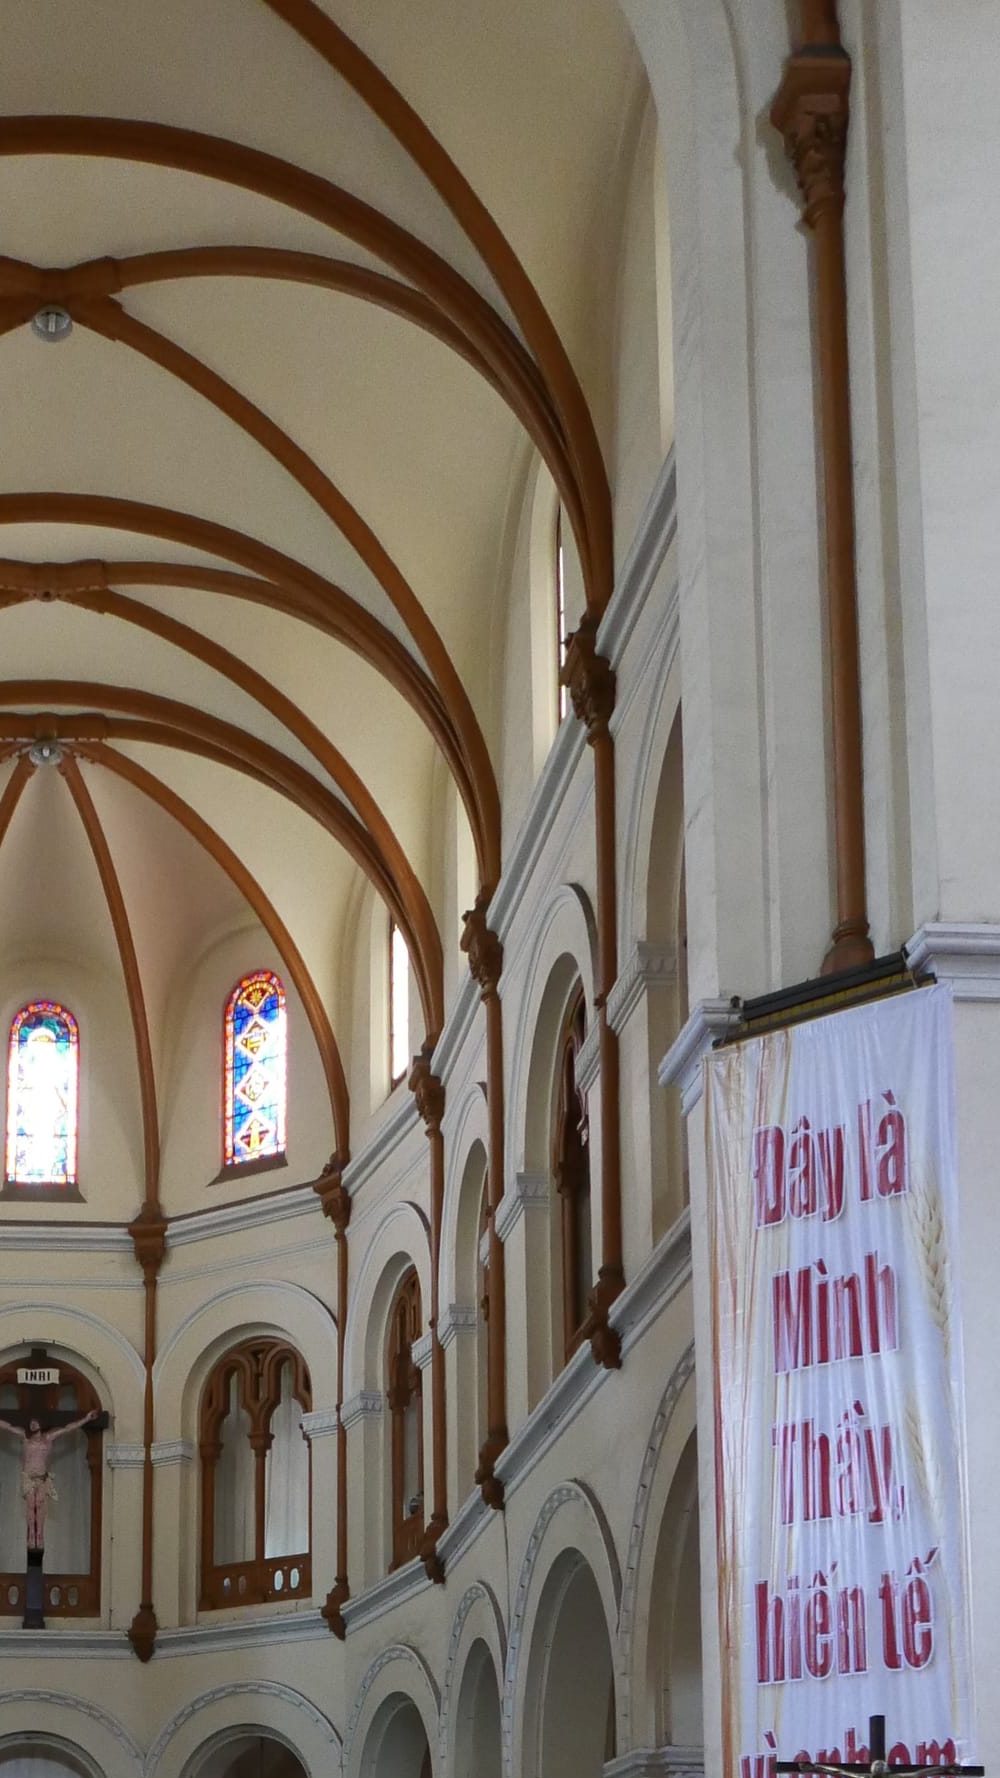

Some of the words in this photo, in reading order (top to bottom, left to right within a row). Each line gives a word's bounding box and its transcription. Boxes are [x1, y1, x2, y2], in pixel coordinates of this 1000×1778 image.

[753, 1115, 845, 1227] Đây
[858, 1089, 907, 1201] là
[25, 1370, 51, 1382] INRI
[772, 1250, 898, 1373] Mình
[755, 1560, 868, 1684] hiến
[878, 1546, 939, 1669] tế
